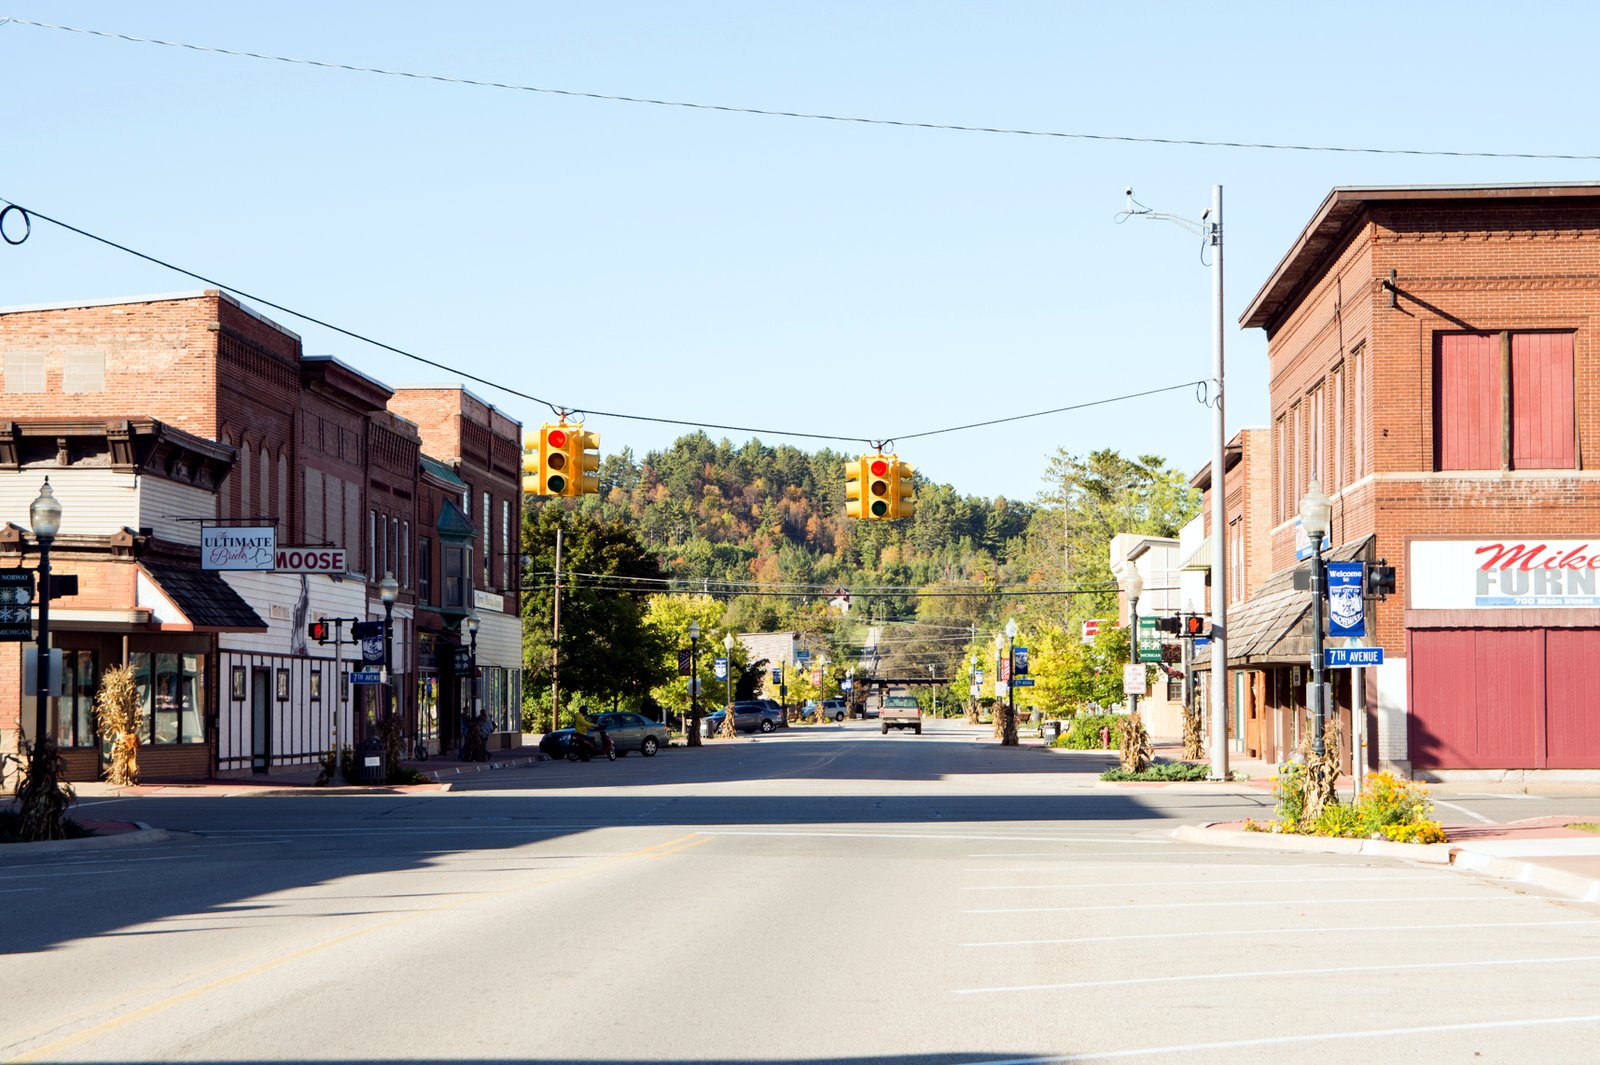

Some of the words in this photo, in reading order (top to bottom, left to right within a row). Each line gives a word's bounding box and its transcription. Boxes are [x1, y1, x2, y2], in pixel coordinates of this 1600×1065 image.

[205, 537, 272, 548] ULTIMATE
[276, 552, 344, 570] MOOSE
[1329, 570, 1362, 578] Welcome
[1476, 566, 1596, 596] FURN
[1513, 597, 1535, 605] 700
[1537, 597, 1563, 605] Main
[1330, 650, 1346, 664] 7TH
[1349, 651, 1379, 663] AVENUE
[353, 673, 364, 682] 7TH
